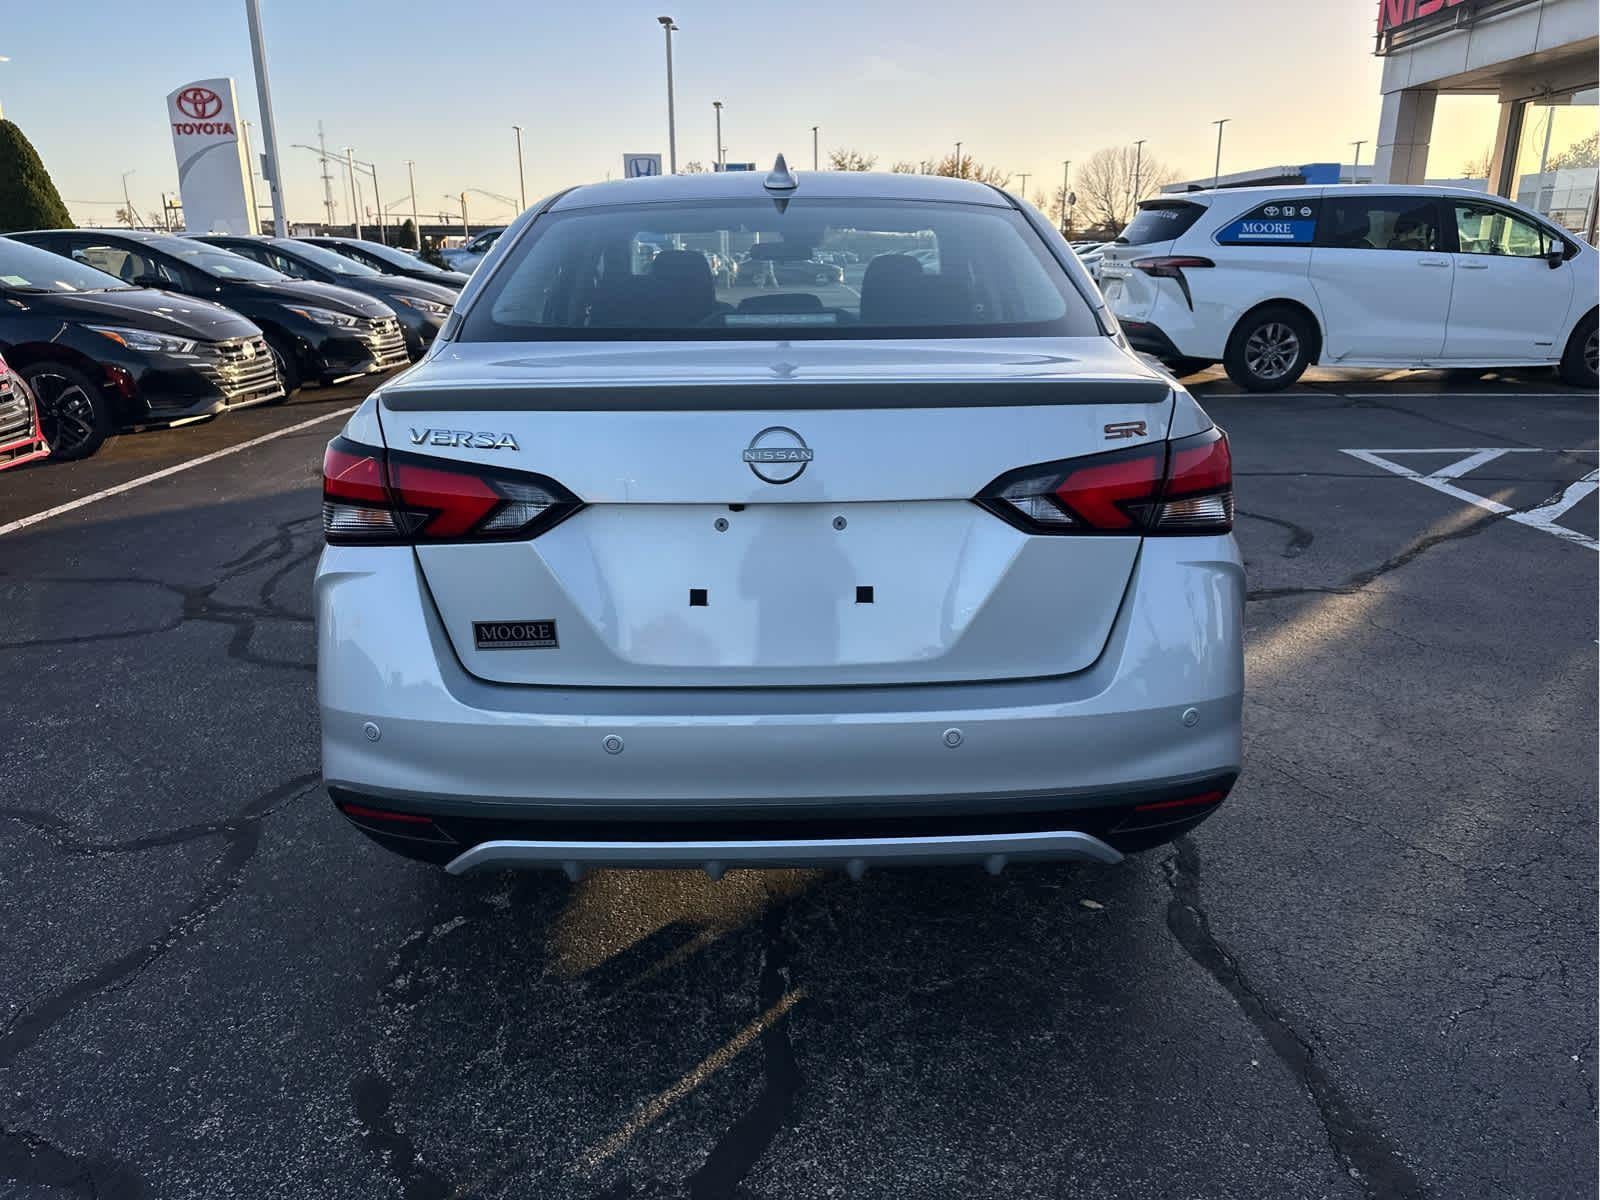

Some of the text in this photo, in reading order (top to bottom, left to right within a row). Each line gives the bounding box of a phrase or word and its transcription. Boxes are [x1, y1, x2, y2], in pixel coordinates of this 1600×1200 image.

[172, 122, 235, 135] TOYOTA
[1242, 223, 1292, 233] MOORE
[1104, 421, 1147, 440] SR
[409, 427, 520, 451] VERSA
[744, 450, 812, 460] NISSAN
[481, 624, 551, 640] MOORE
